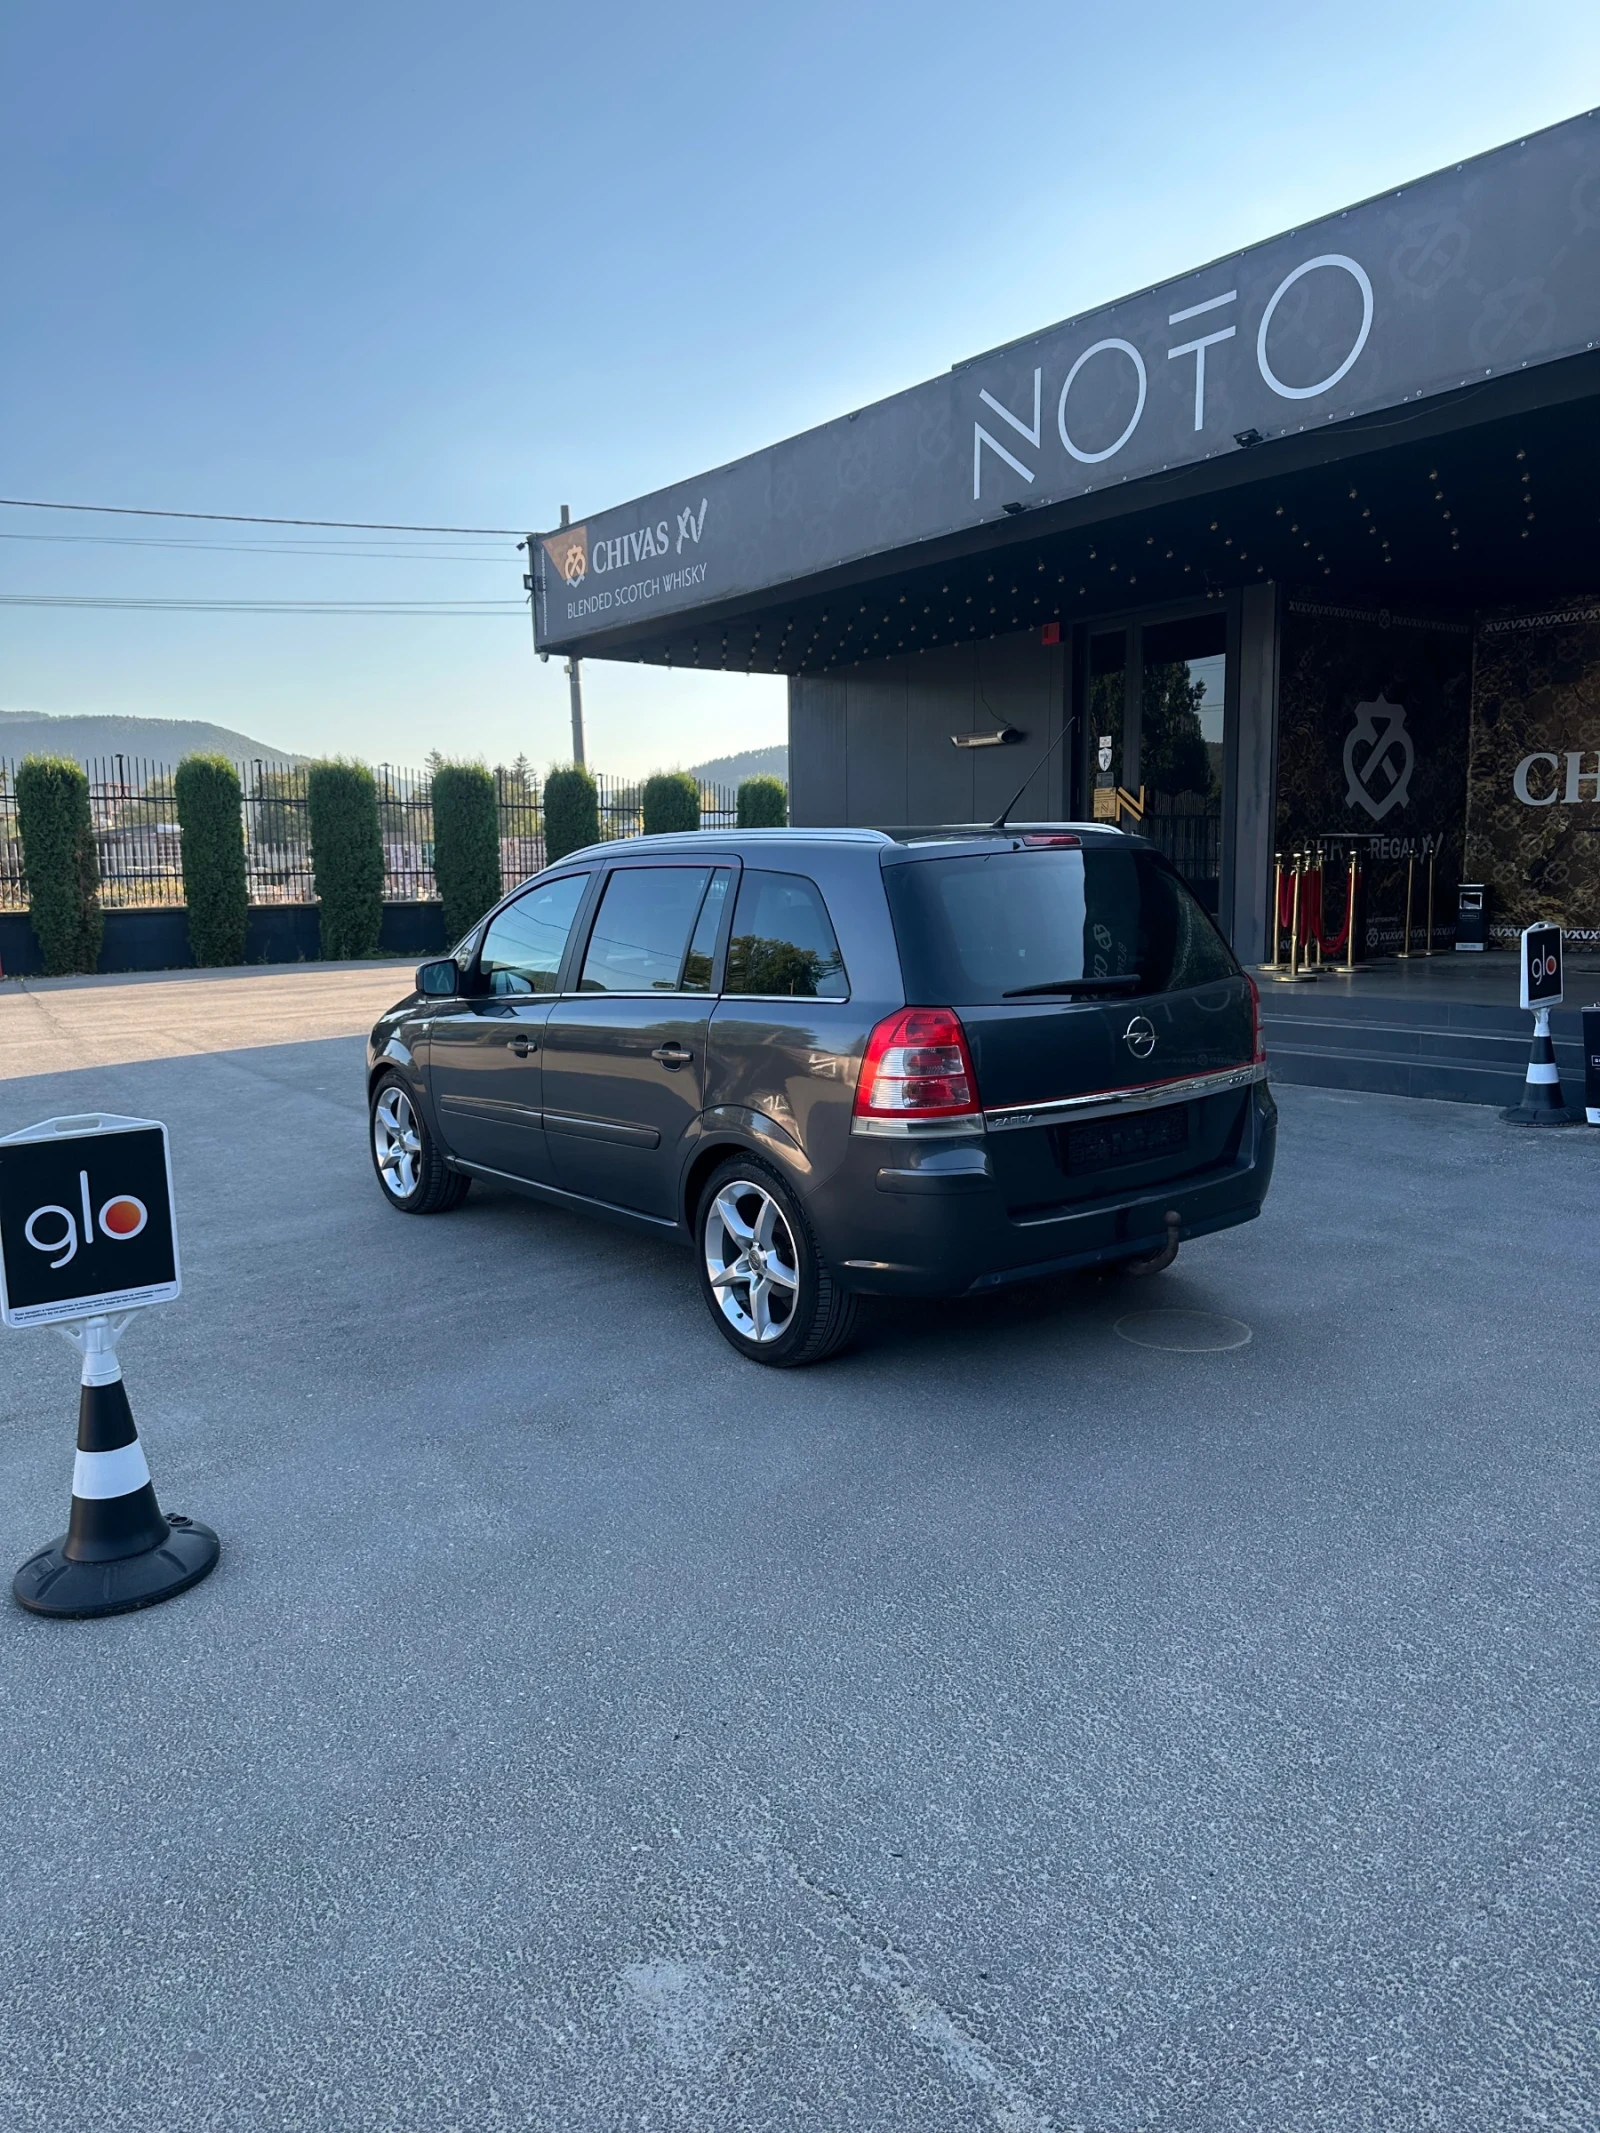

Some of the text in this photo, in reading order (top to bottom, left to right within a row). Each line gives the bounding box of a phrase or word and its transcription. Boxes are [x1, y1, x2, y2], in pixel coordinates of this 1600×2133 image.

[973, 253, 1374, 500] NOTO
[592, 498, 708, 574] CHIVAS XV
[567, 562, 708, 619] BLENDED SCOTCH WHISKY
[1531, 944, 1557, 985] glo
[24, 1170, 148, 1269] glo
